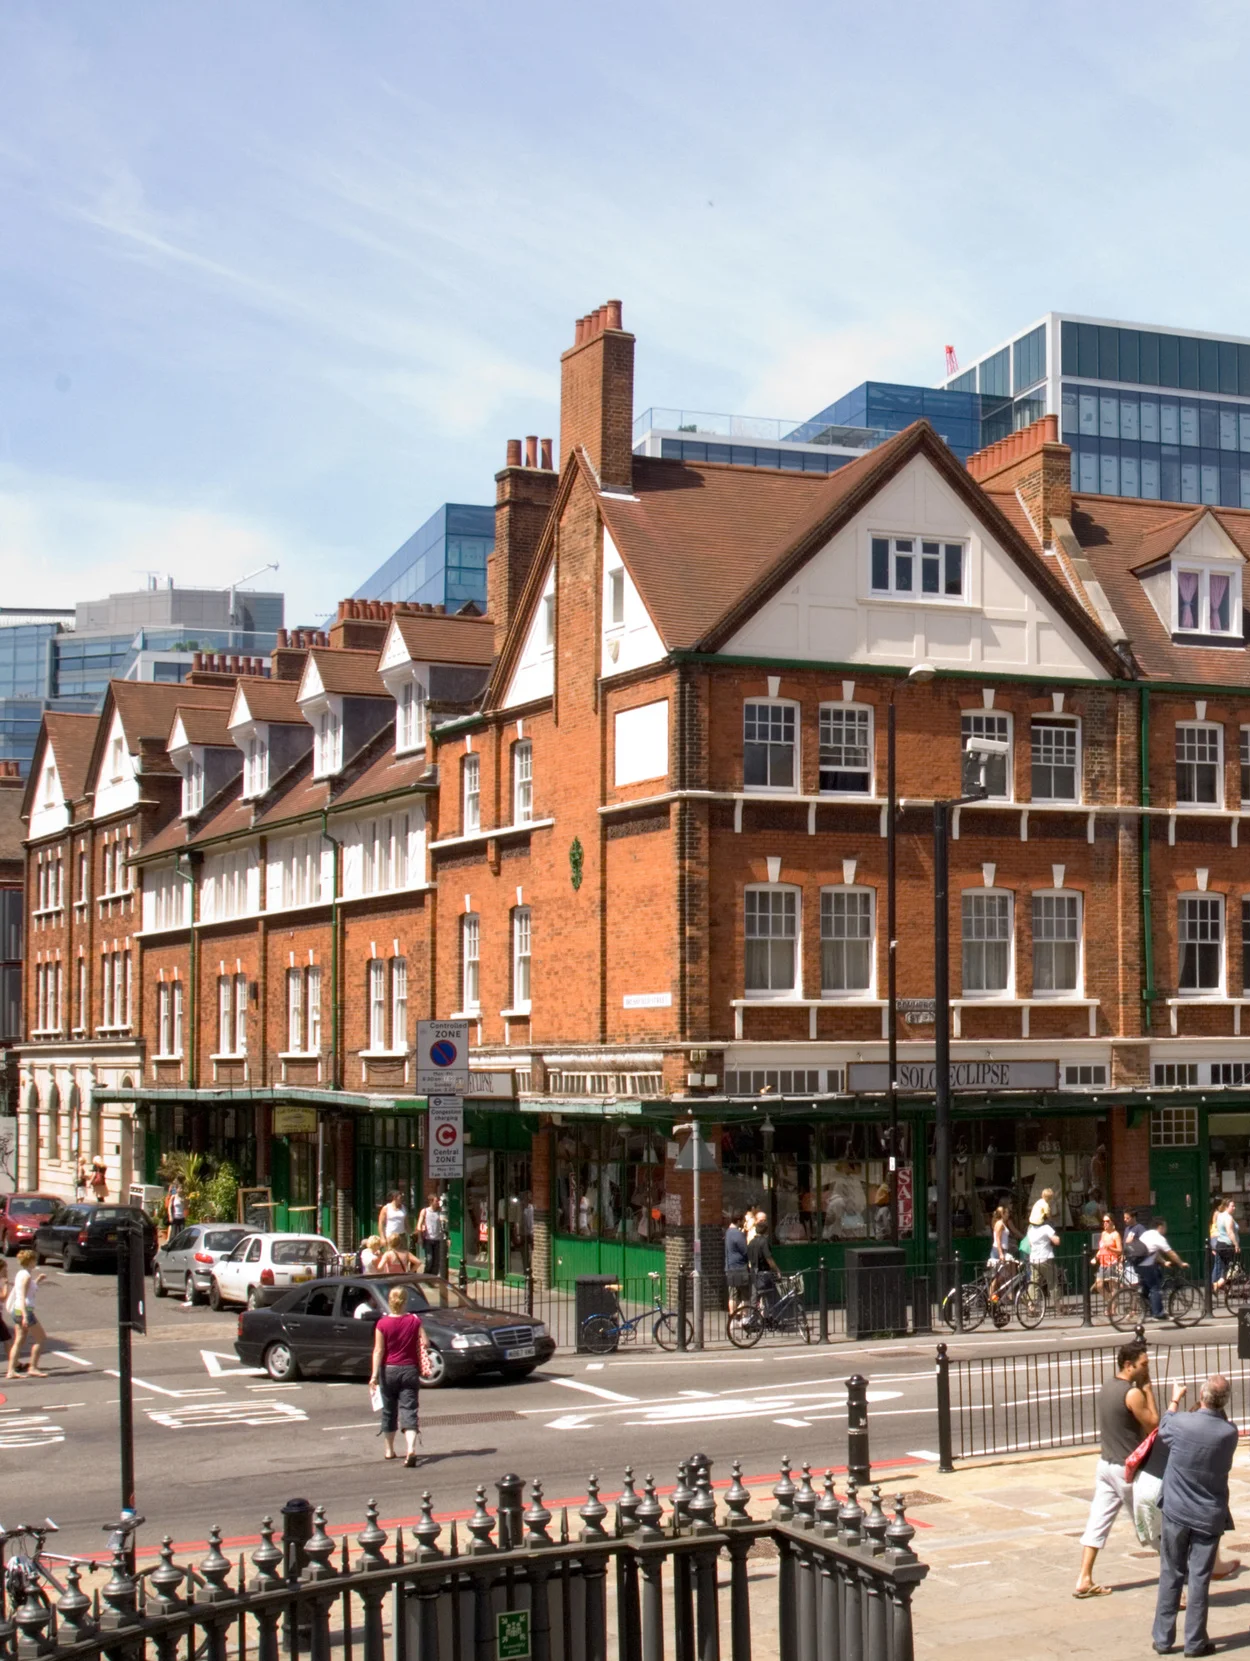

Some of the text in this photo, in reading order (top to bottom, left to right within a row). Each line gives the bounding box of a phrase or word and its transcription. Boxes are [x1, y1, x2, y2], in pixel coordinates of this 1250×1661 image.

[435, 1030, 461, 1038] ZONE
[948, 1063, 1010, 1086] ECLIPSE
[898, 1169, 912, 1229] SALE
